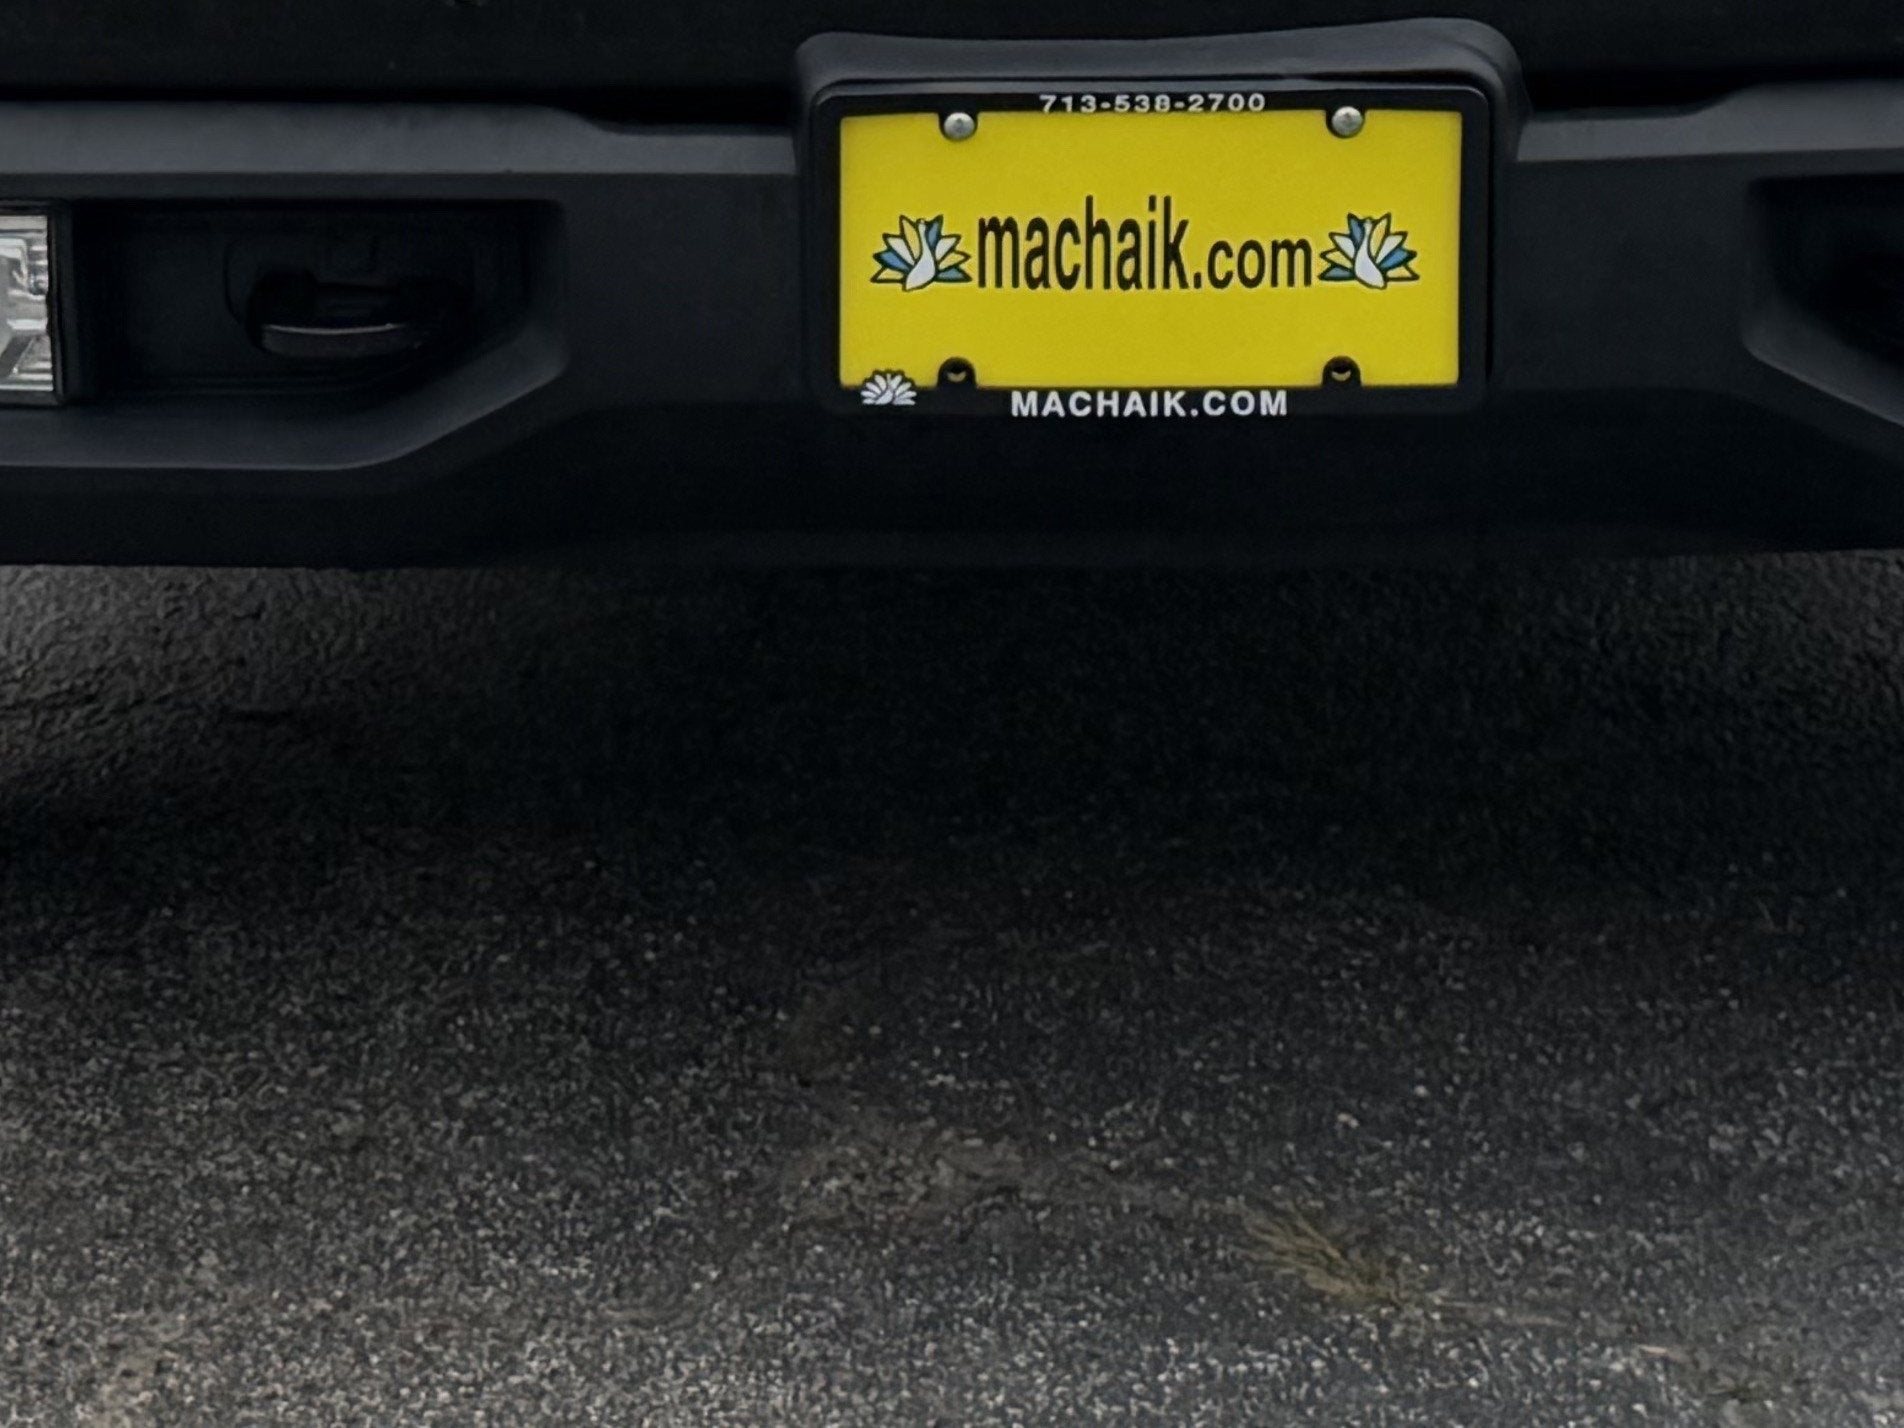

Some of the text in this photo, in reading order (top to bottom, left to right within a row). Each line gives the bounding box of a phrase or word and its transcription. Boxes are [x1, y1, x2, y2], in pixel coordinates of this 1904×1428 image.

[1038, 93, 1268, 115] 713-538-2700
[977, 194, 1313, 290] machaik.com
[1010, 389, 1289, 418] MACHAIK.COM
